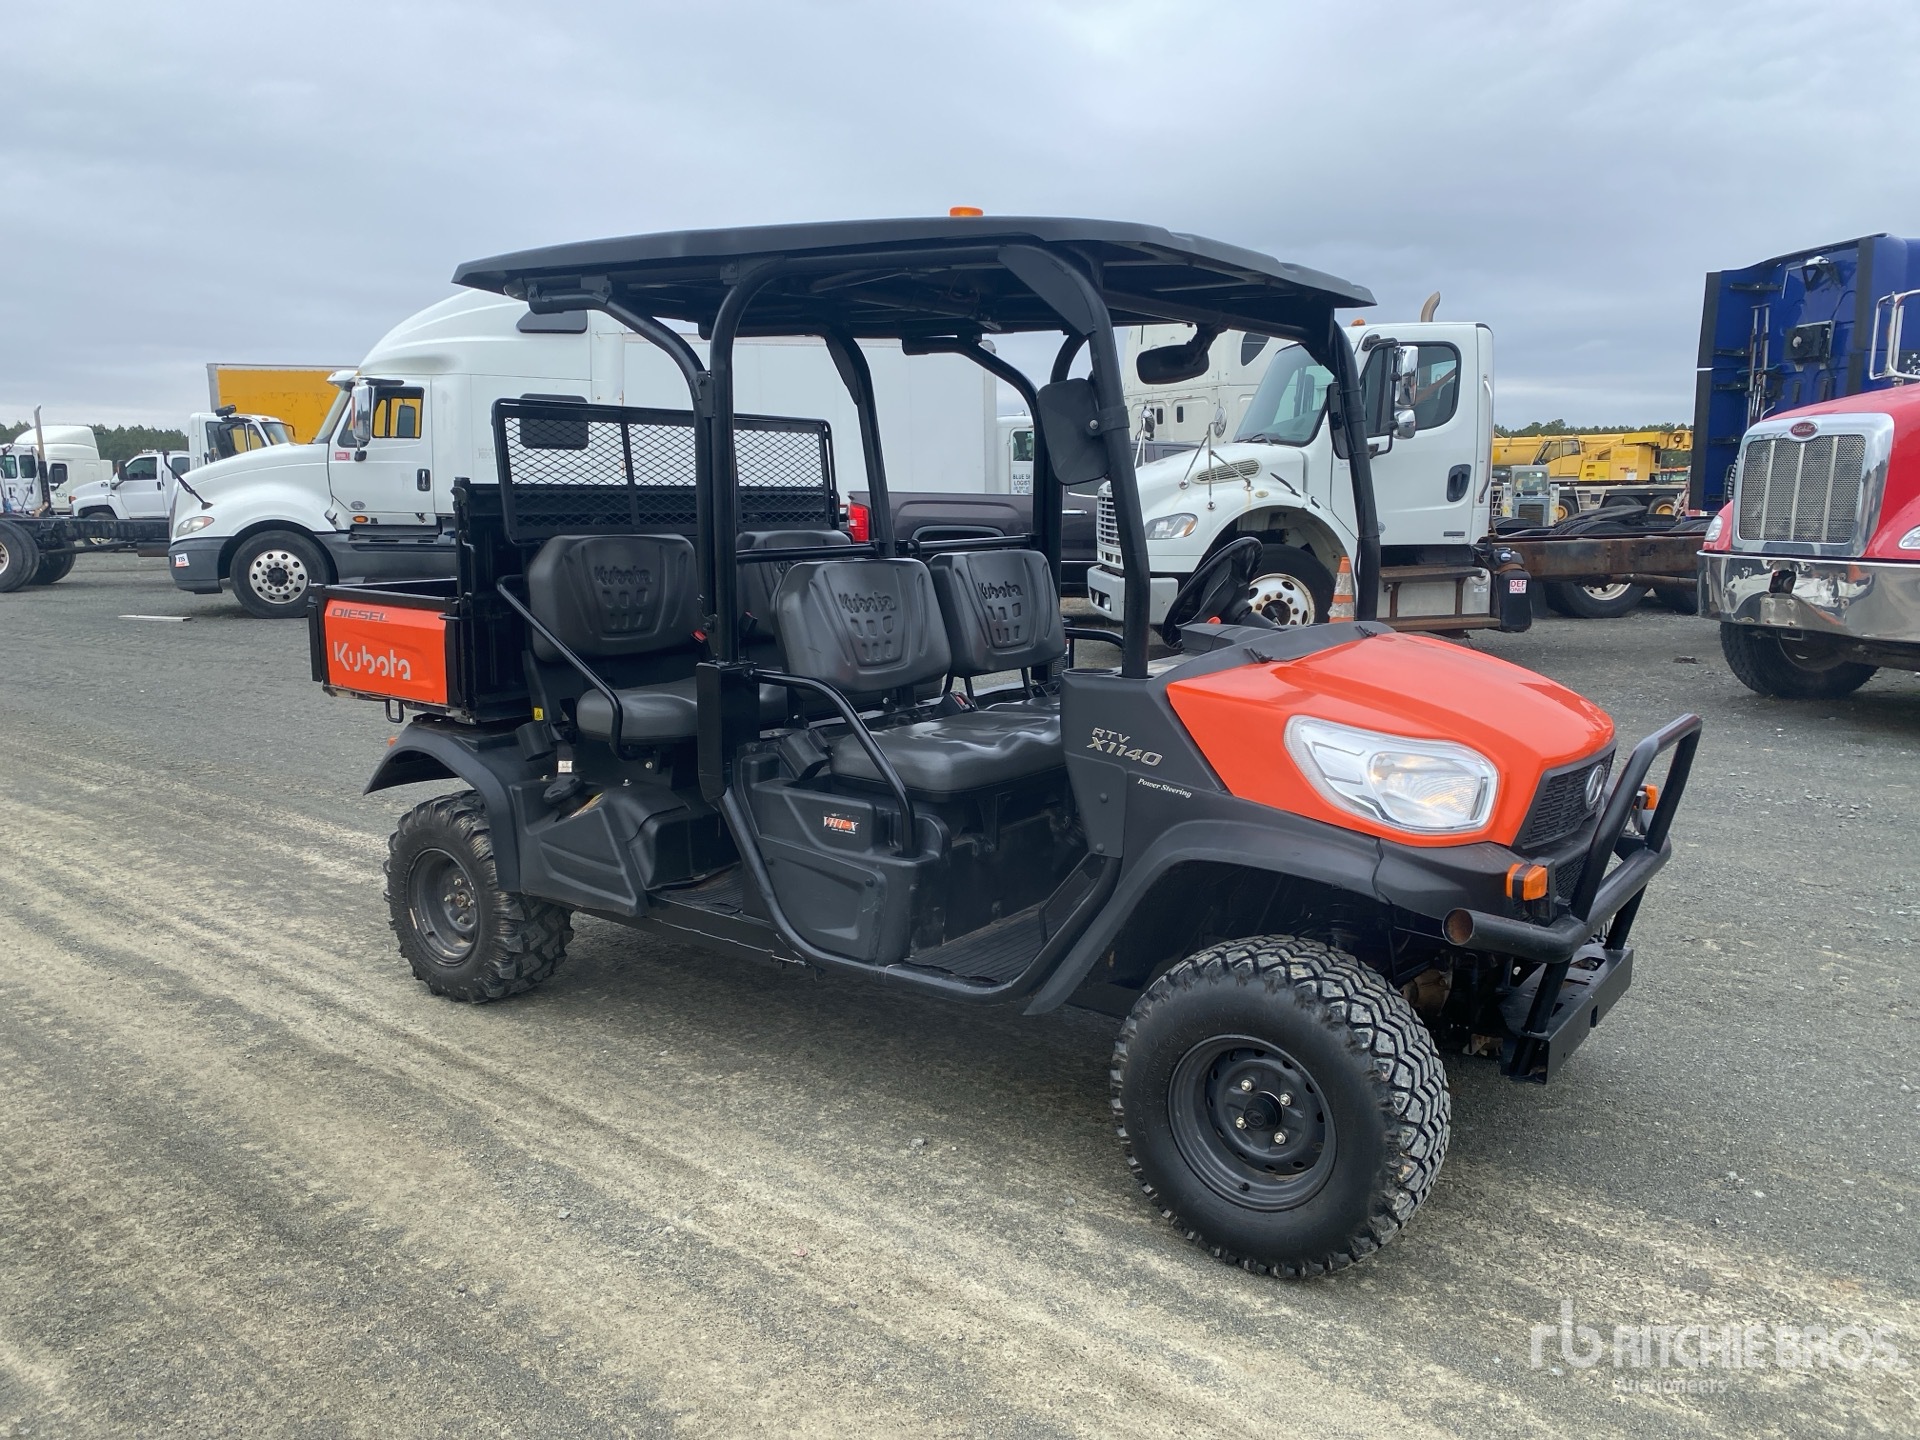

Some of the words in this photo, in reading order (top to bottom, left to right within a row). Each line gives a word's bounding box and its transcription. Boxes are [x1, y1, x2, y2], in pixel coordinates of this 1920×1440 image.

[978, 581, 1023, 599] Kubota
[838, 591, 897, 613] Kubota
[331, 607, 390, 623] DIESEL
[333, 640, 412, 681] Kubota
[1091, 727, 1131, 743] RTV
[1086, 736, 1163, 766] X1140
[1137, 778, 1161, 789] Power
[1160, 784, 1192, 799] Steering
